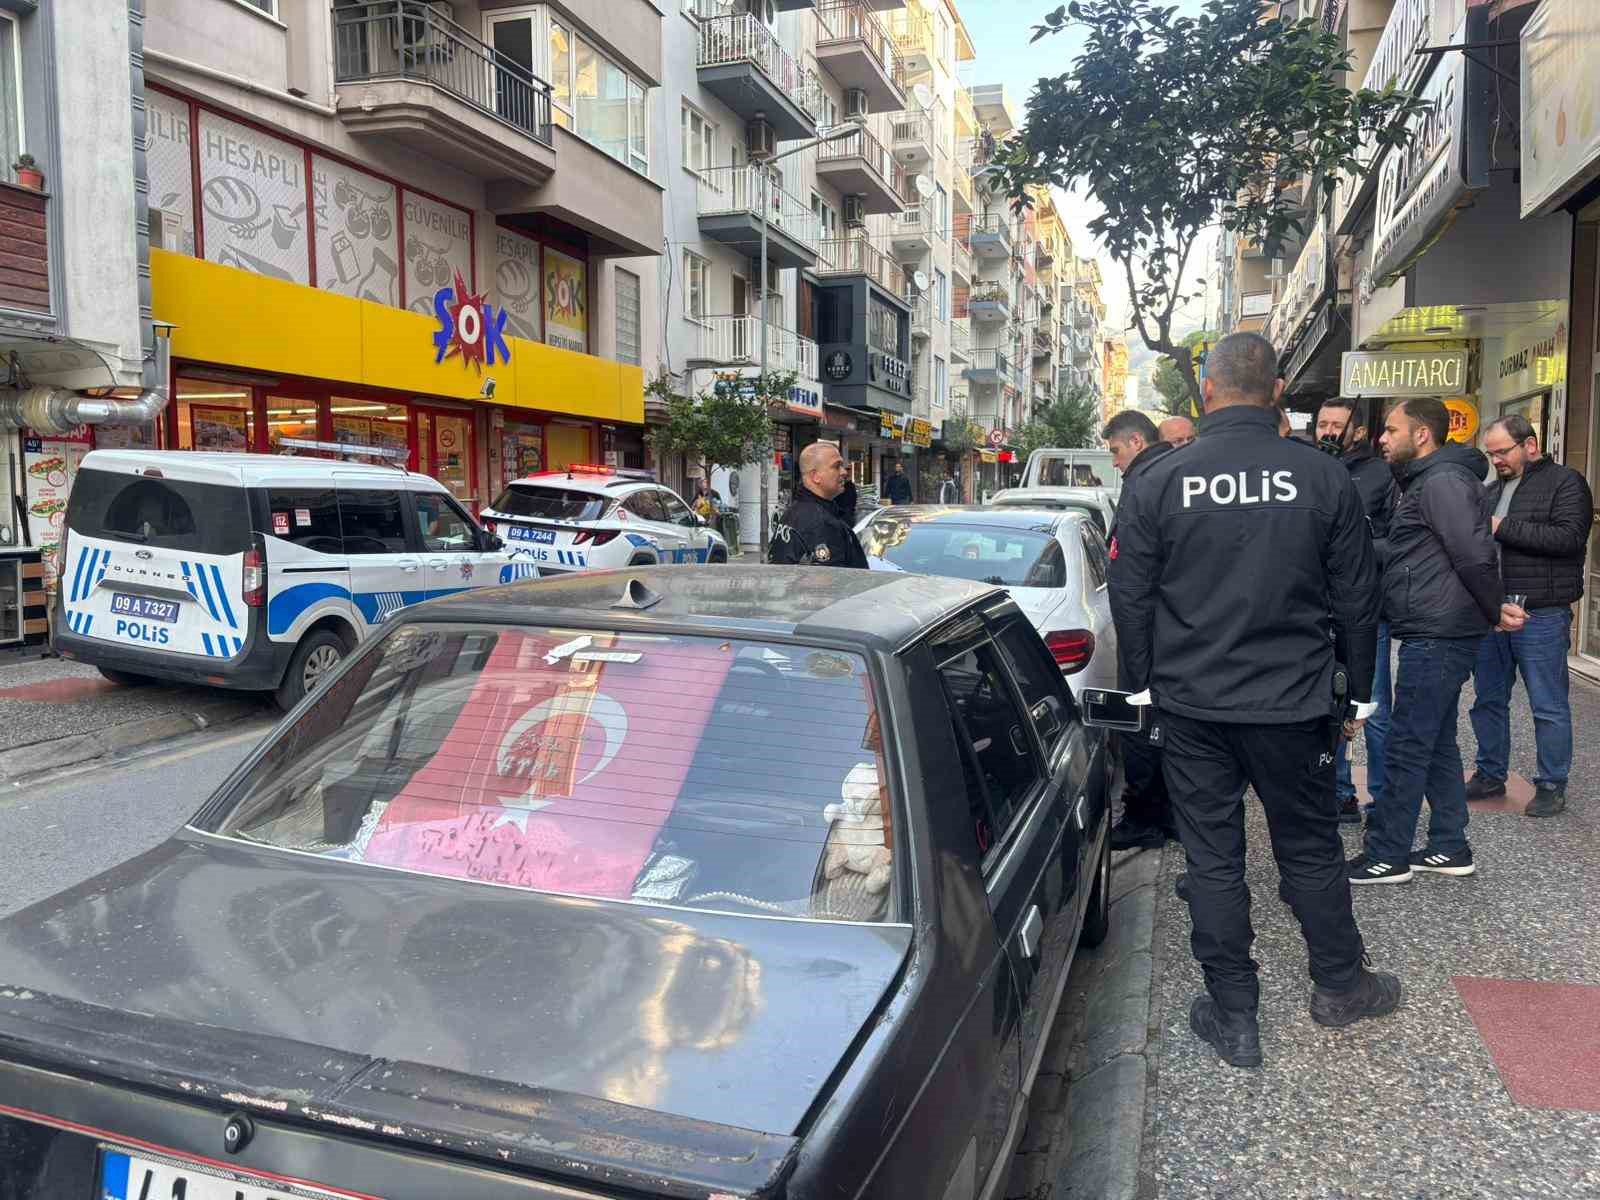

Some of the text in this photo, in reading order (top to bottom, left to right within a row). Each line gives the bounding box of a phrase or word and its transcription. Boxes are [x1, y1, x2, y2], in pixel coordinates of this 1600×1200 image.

[205, 129, 299, 188] HESAPLI
[1349, 358, 1461, 389] ANAHTARCI
[1499, 349, 1528, 378] DURMAZ
[511, 528, 522, 537] 09
[523, 529, 530, 538] A
[116, 597, 174, 617] 09 A 7327
